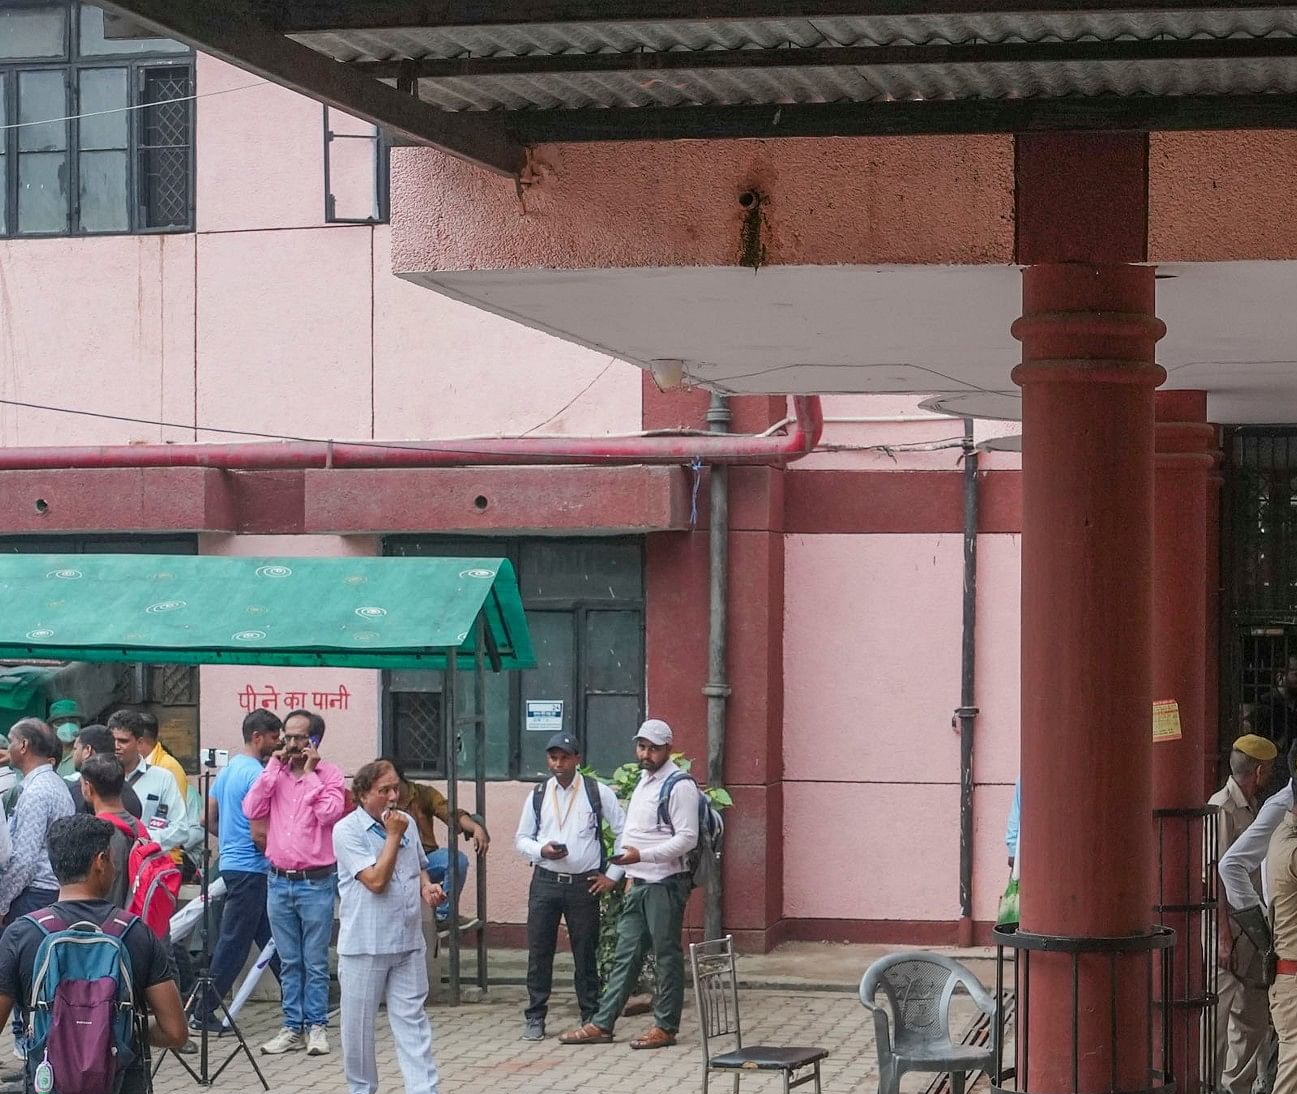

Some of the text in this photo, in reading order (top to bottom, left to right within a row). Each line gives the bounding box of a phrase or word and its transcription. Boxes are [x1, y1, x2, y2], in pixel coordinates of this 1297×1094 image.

[237, 684, 352, 712] पीने का पानी
